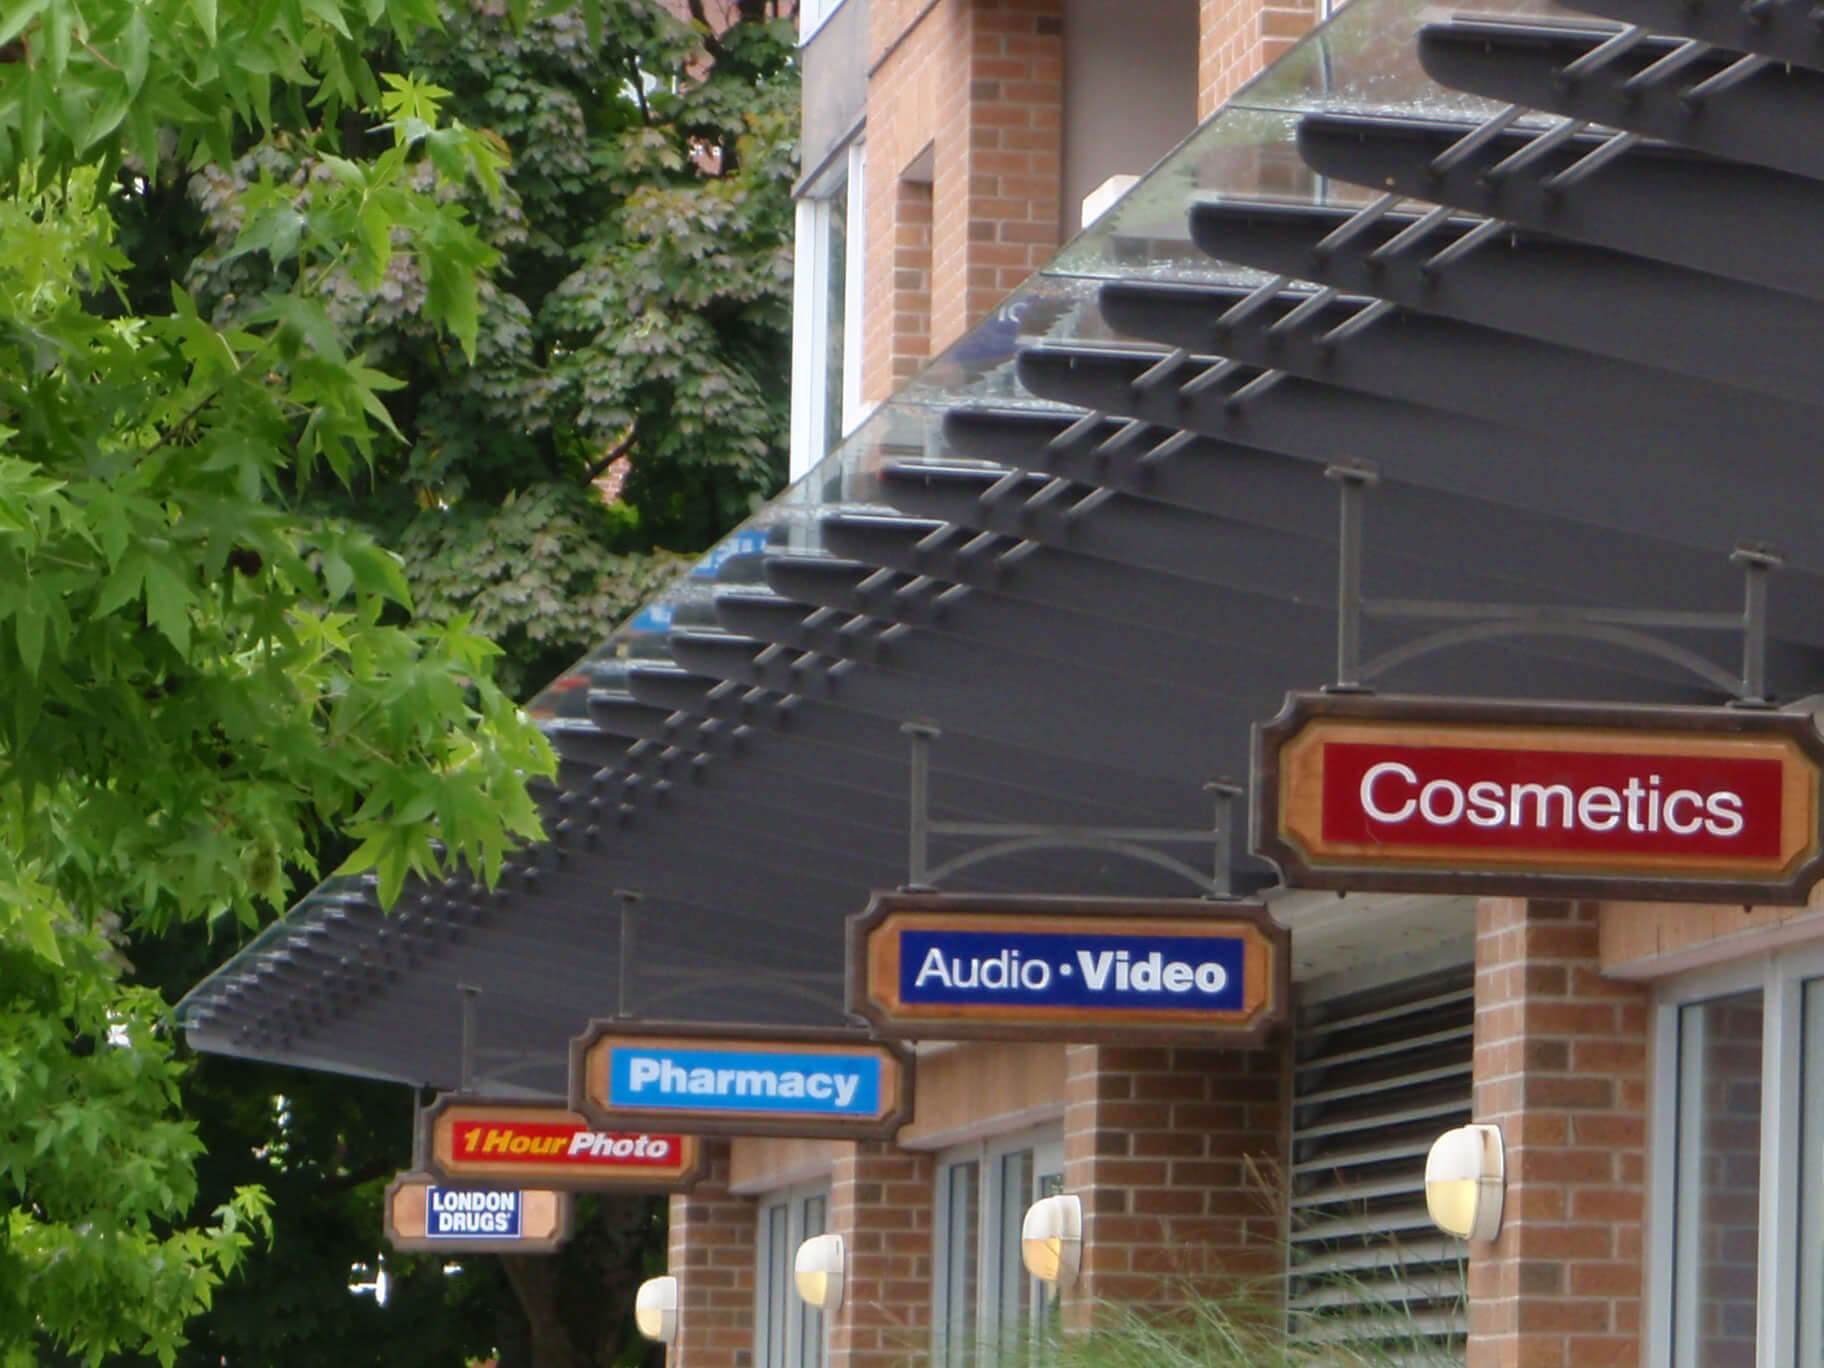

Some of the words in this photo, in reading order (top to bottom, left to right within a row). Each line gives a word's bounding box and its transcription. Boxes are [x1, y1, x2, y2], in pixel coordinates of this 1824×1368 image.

[1359, 761, 1745, 836] Cosmetics
[914, 946, 1051, 990] Audio
[1076, 950, 1228, 993] Video
[628, 1057, 859, 1107] Pharmacy
[464, 1128, 481, 1152] 1
[482, 1129, 569, 1155] Hour
[568, 1131, 670, 1158] Photo
[432, 1190, 515, 1213] LONDON
